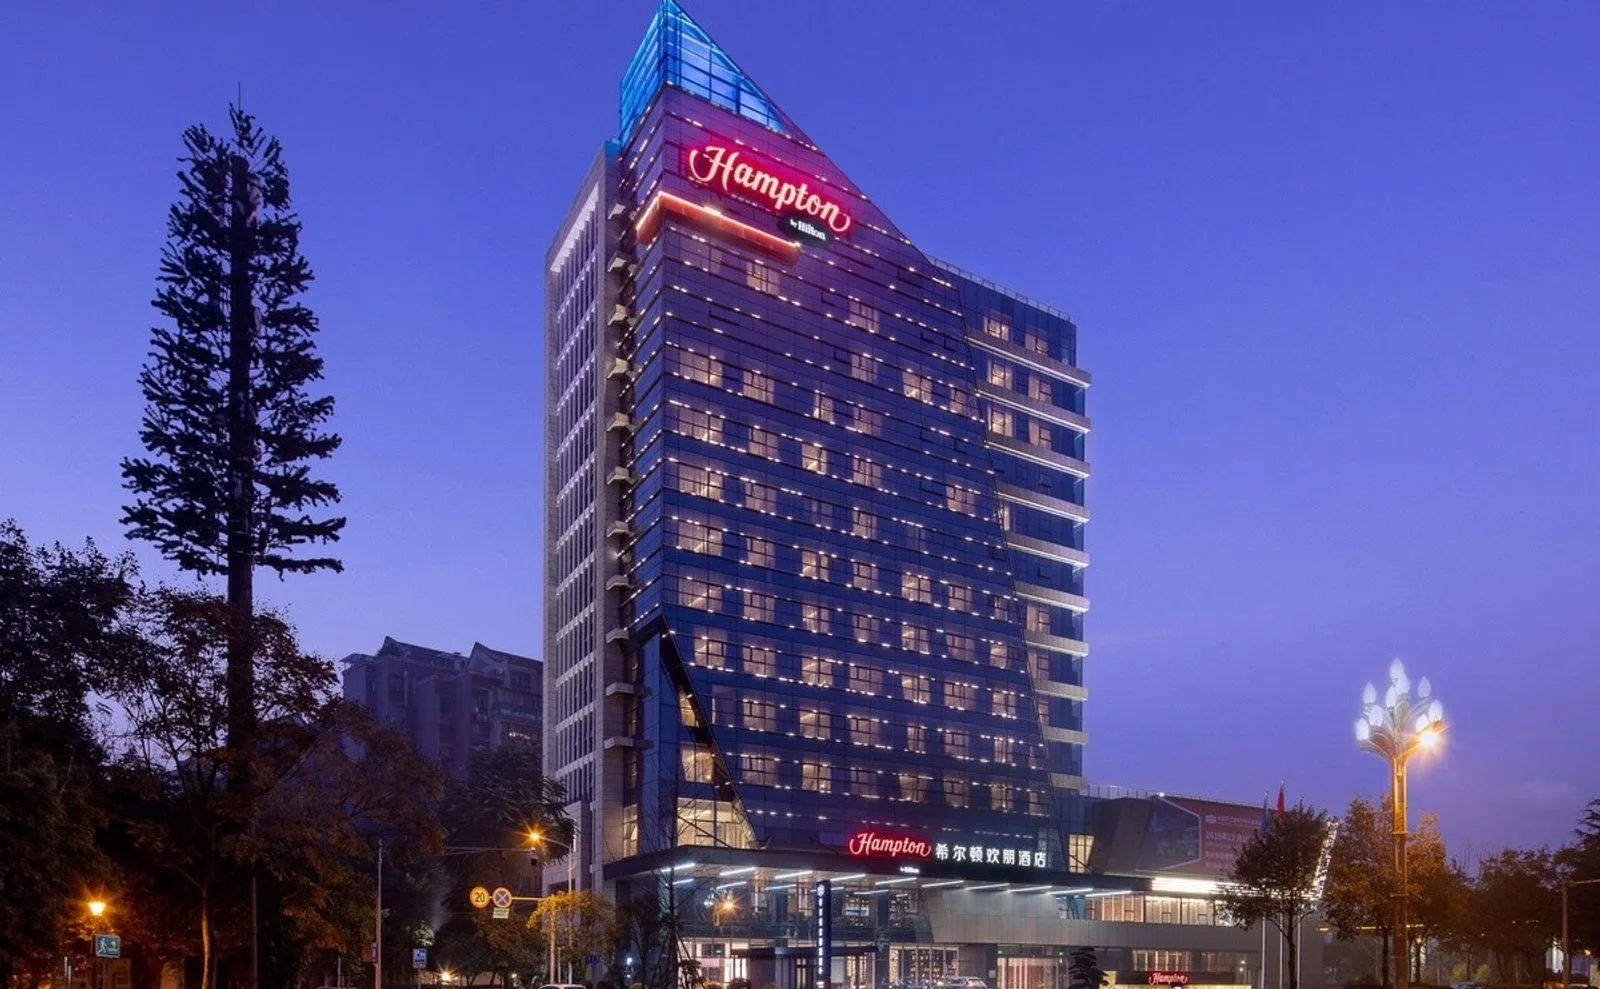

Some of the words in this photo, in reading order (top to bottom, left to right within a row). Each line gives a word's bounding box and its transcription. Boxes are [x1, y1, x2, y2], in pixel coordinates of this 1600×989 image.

[689, 145, 851, 232] Hampton
[790, 218, 798, 228] by
[797, 220, 826, 241] Hilton
[850, 832, 931, 857] Hampton
[935, 843, 1047, 868] 希尔顿欢朋酒店
[474, 891, 485, 903] 20
[1148, 972, 1188, 985] Hampton
